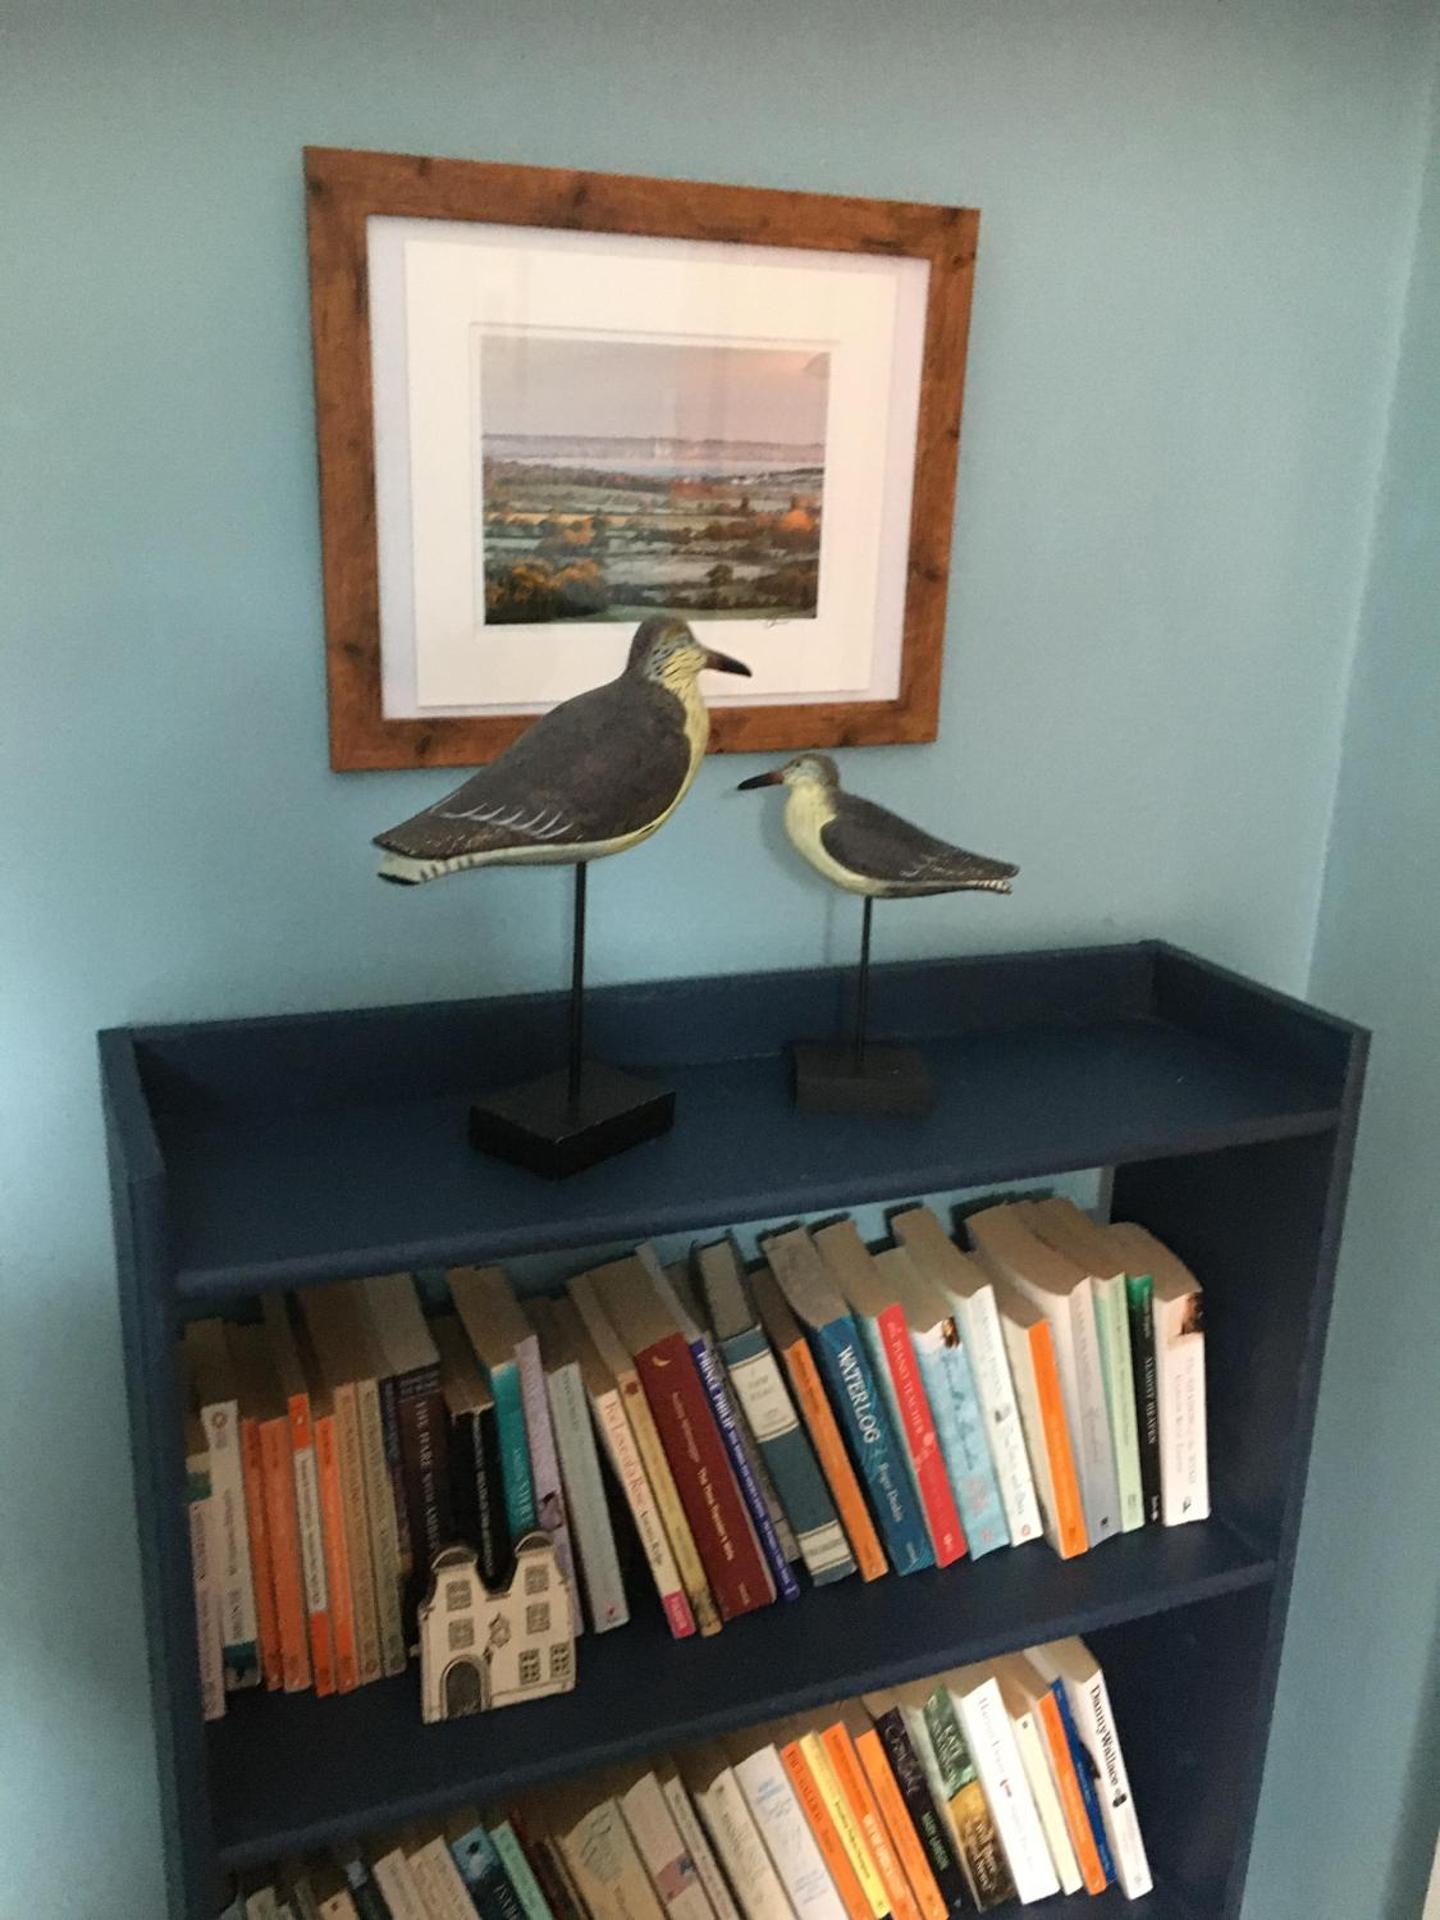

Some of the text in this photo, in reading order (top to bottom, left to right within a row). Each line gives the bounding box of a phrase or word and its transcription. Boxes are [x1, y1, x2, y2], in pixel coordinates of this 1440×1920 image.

[696, 1350, 735, 1432] PRINCE PHILIP
[835, 1344, 879, 1444] WATERLOG
[902, 1380, 924, 1436] TEACHER
[1144, 1356, 1157, 1444] ALMOST HEAVEN
